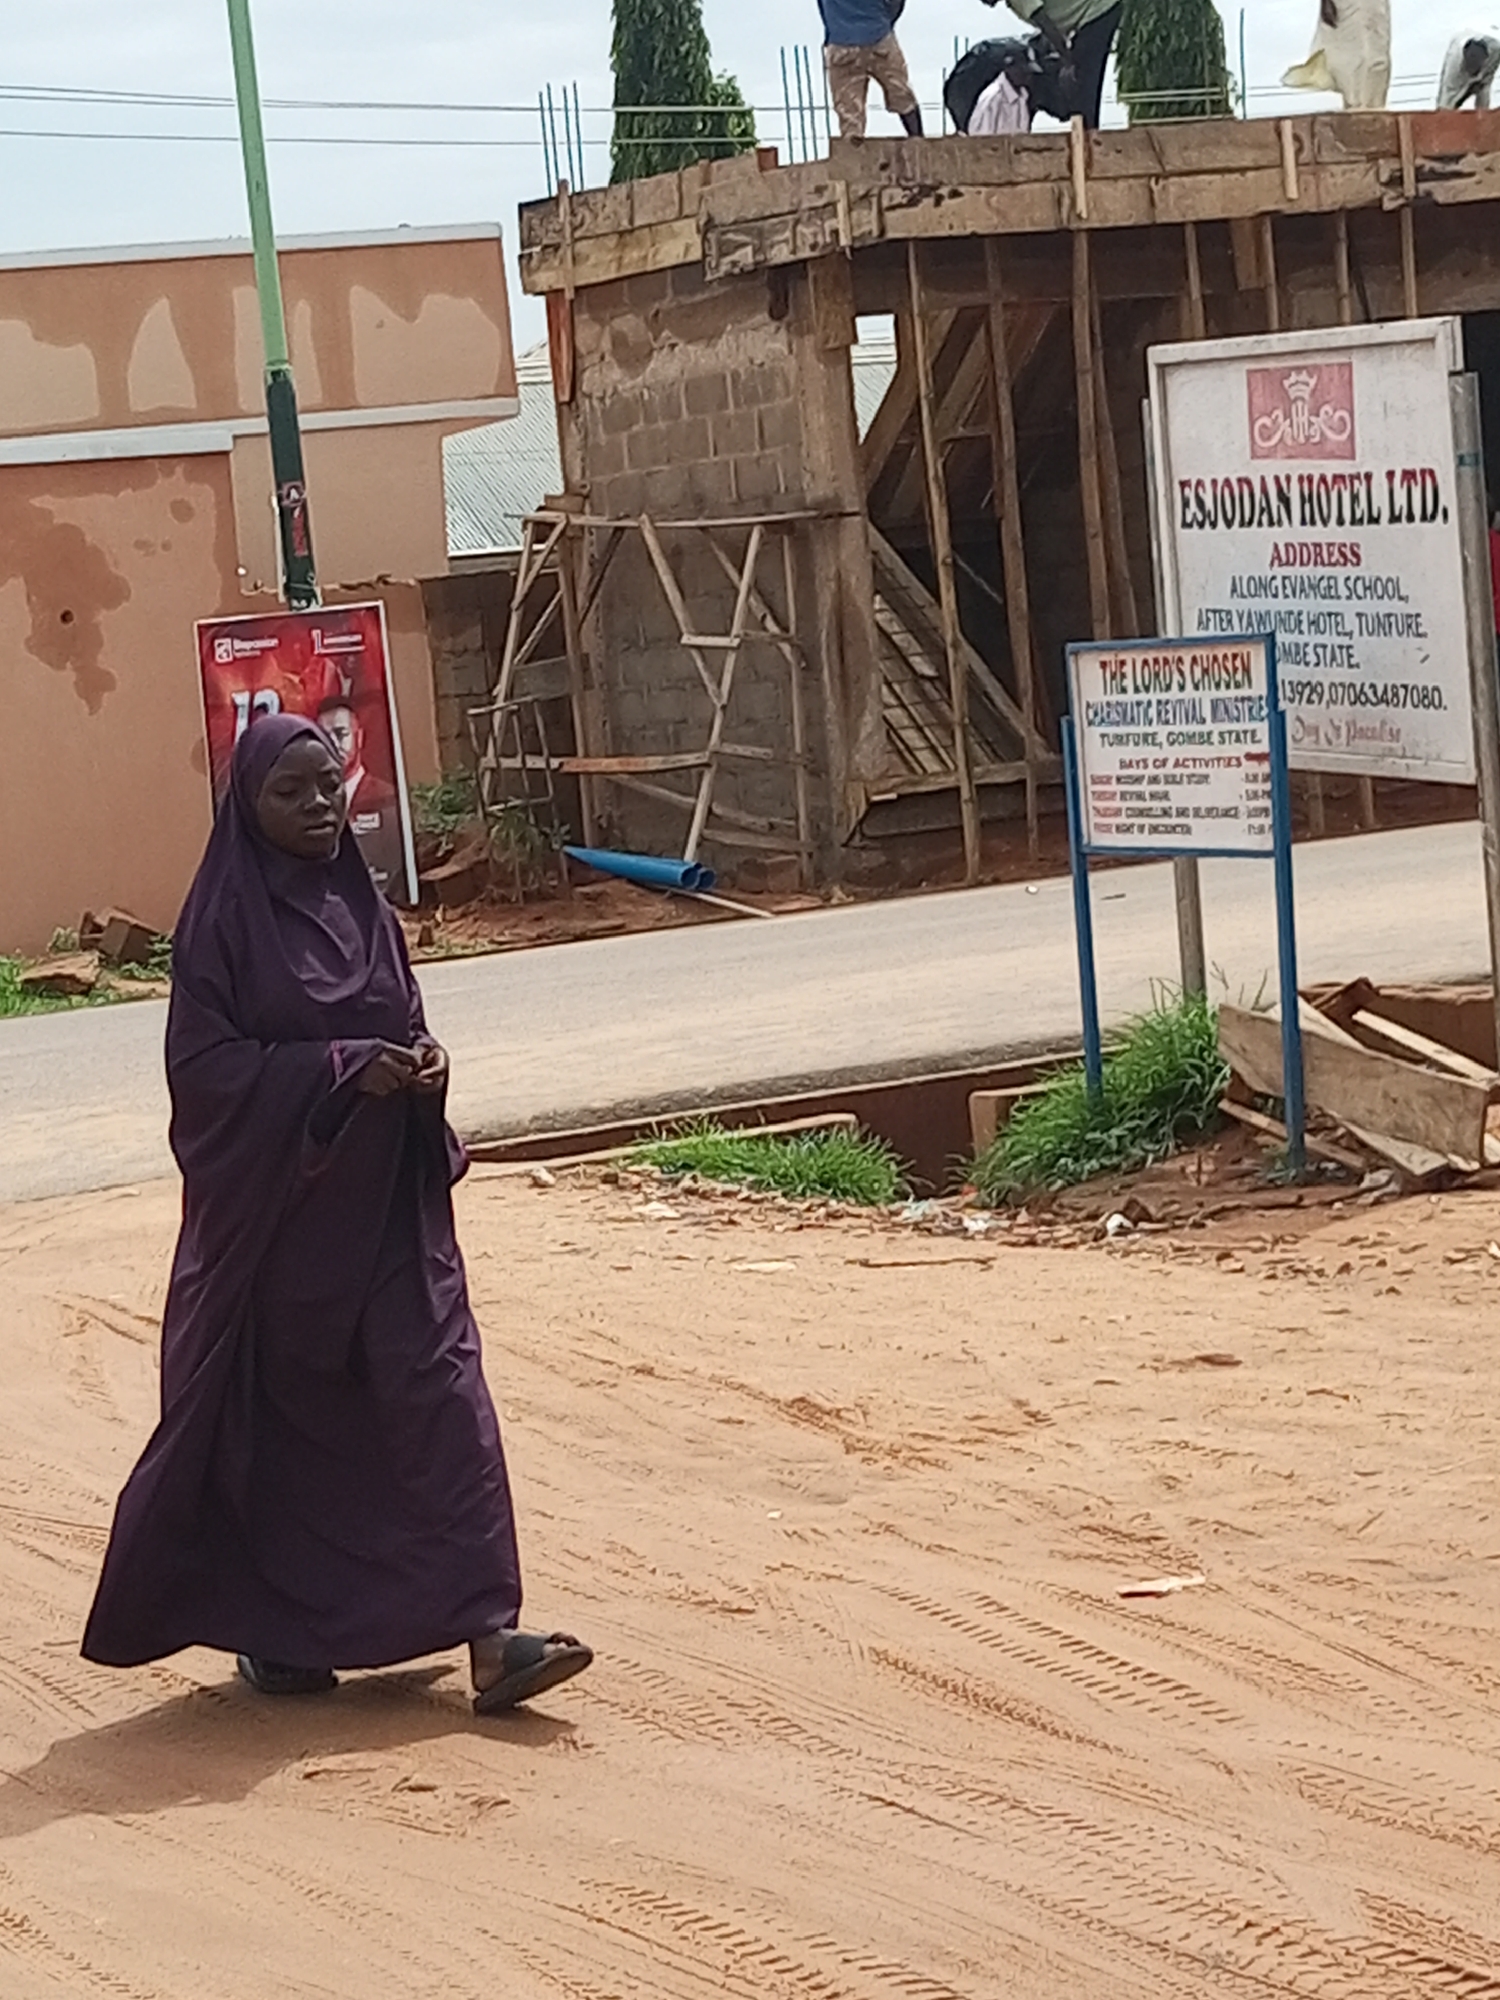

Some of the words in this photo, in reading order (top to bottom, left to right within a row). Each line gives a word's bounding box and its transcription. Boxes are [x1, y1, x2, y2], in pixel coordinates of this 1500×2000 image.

[1179, 474, 1292, 530] ESJODAN
[1298, 471, 1381, 527] HOTEL
[1386, 467, 1450, 525] LTD.
[1269, 541, 1362, 569] ADDRESS
[1230, 576, 1279, 599] ALONG
[1282, 575, 1343, 600] EVANGEL
[1344, 575, 1410, 604] SCHOOL,
[1197, 608, 1233, 632] AFTER
[1236, 608, 1304, 636] YAWUNDE
[1306, 611, 1354, 640] HOTEL,
[1355, 612, 1429, 639] TUNFURE.
[1313, 643, 1361, 670] STATE.
[1099, 654, 1128, 696] THE
[1132, 655, 1186, 694] LORD'S
[1190, 650, 1253, 692] CHOSEN
[1086, 699, 1153, 727] CHARISMATIC
[1156, 697, 1206, 725] REVIVAL
[1210, 695, 1266, 724] MINISTRIE
[1166, 730, 1214, 746] GOMBE
[1152, 758, 1169, 769] OF
[1172, 756, 1242, 769] ACTIVITIES
